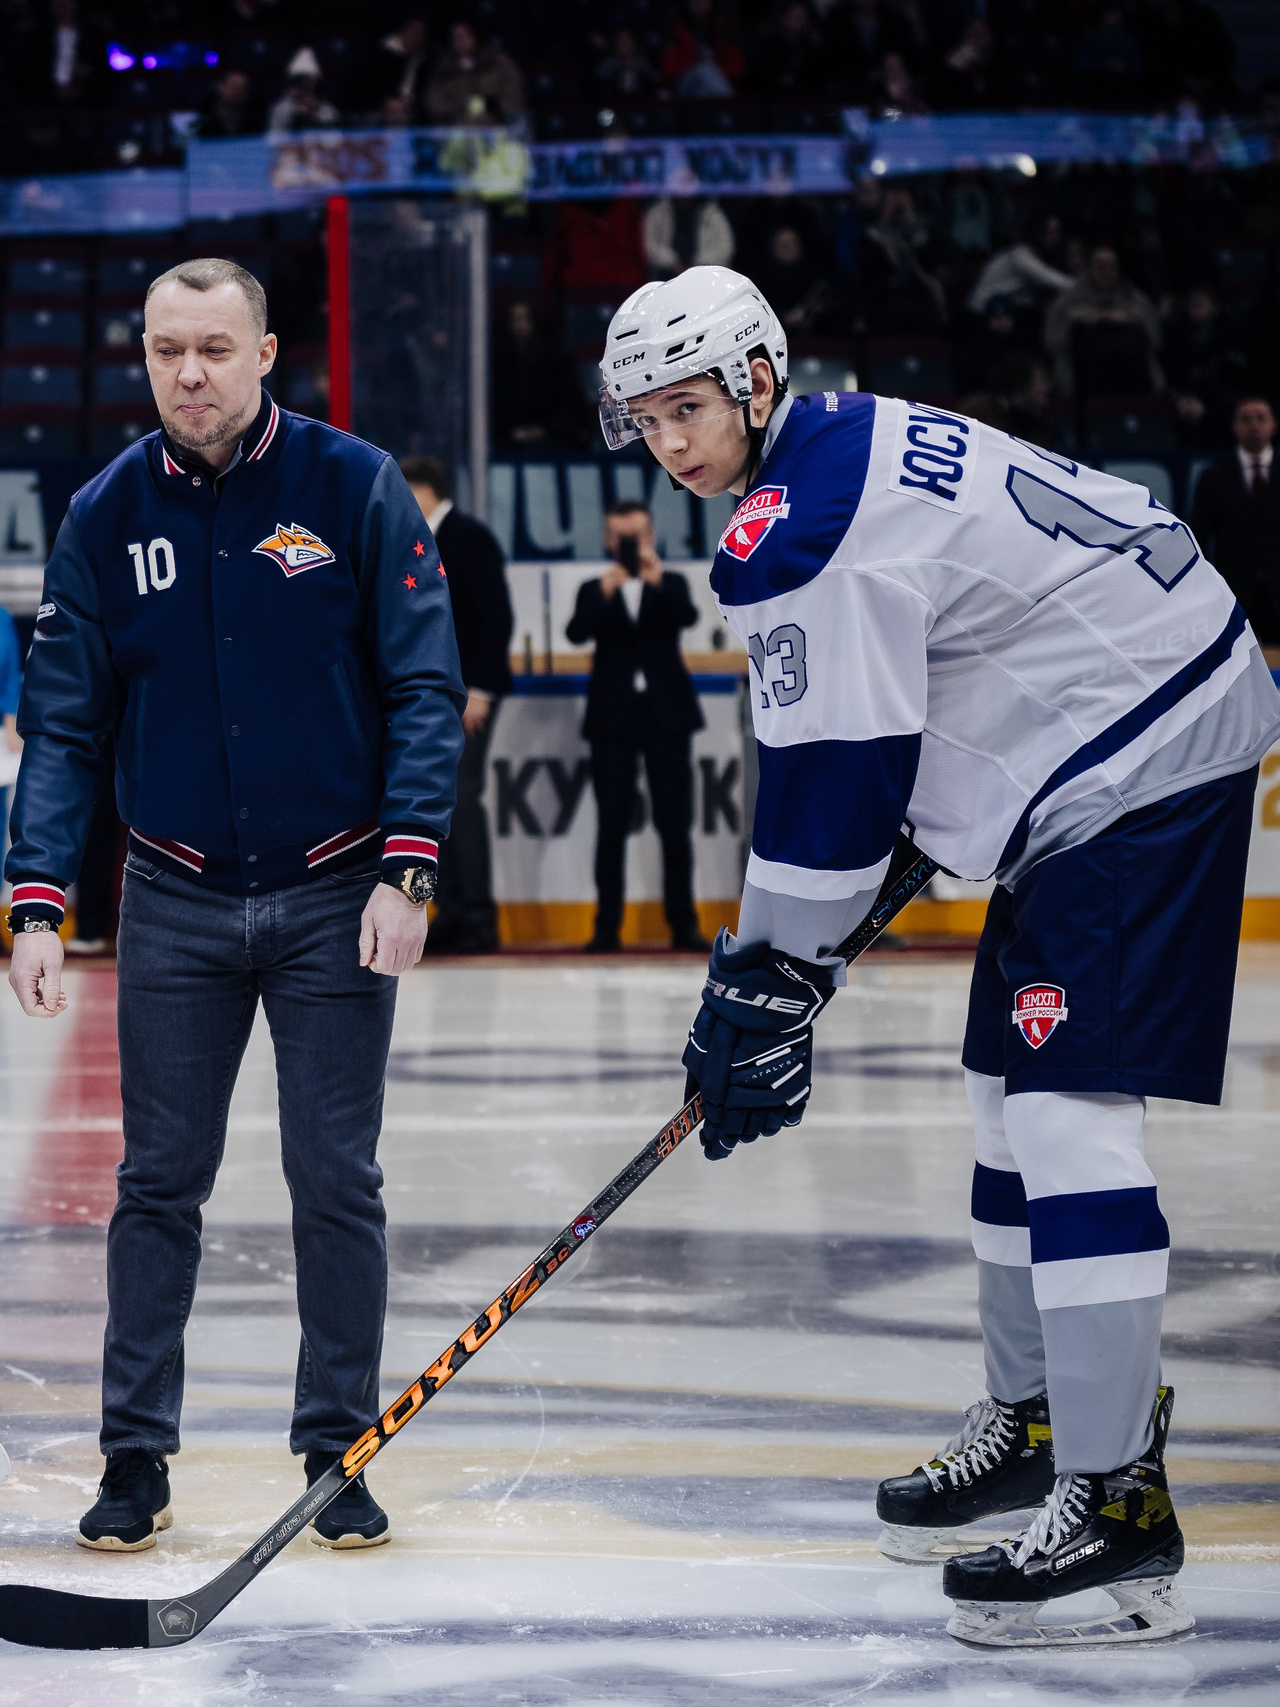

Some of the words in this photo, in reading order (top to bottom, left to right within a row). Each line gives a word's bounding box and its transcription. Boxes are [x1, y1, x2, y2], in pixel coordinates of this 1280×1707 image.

[734, 320, 760, 342] CCM
[613, 352, 646, 369] CCM
[899, 402, 970, 502] ЮСУ
[128, 537, 177, 595] 10
[493, 757, 739, 838] КУК
[704, 977, 808, 1015] RUE
[1022, 993, 1056, 1008] НМХЛ
[1038, 1009, 1063, 1017] РОССИИ
[341, 1263, 541, 1477] SOYUZ
[1054, 1539, 1106, 1571] BAUER
